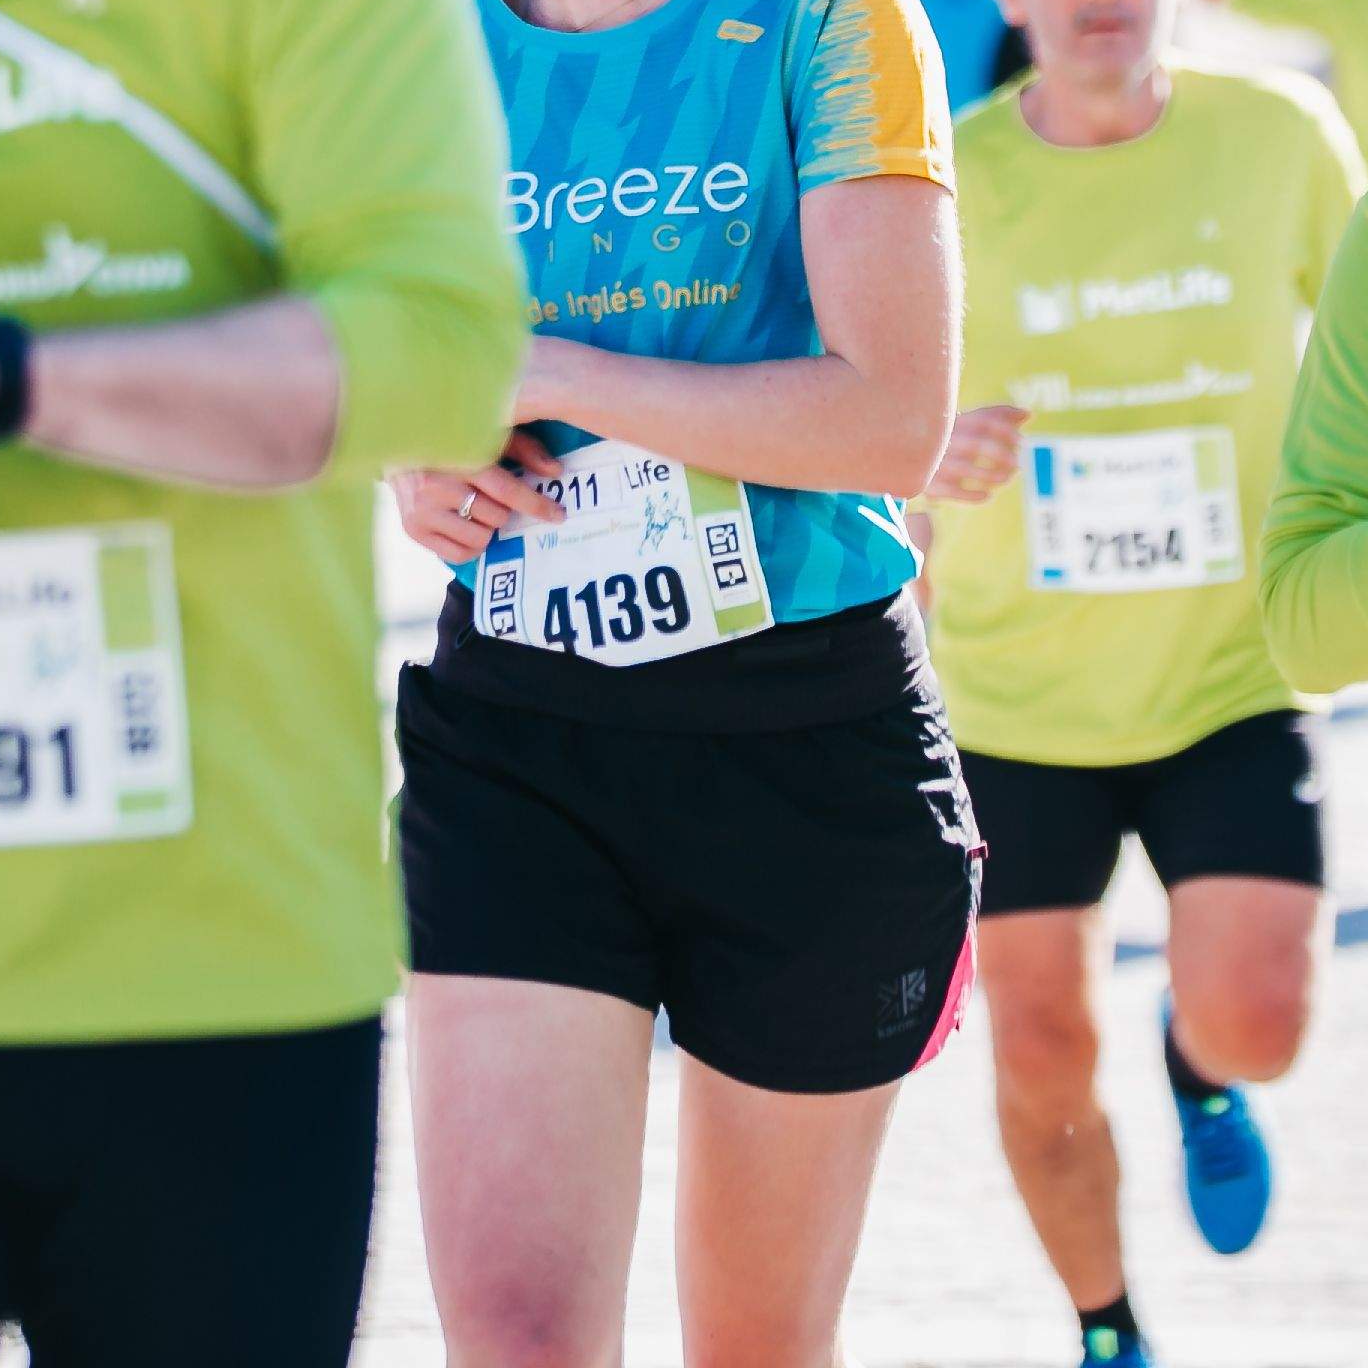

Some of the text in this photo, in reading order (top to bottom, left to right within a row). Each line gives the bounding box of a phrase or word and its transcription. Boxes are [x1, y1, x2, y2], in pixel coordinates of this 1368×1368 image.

[503, 161, 750, 234] Breeze
[653, 278, 741, 310] Online
[535, 473, 598, 510] 211
[543, 565, 692, 654] 4139
